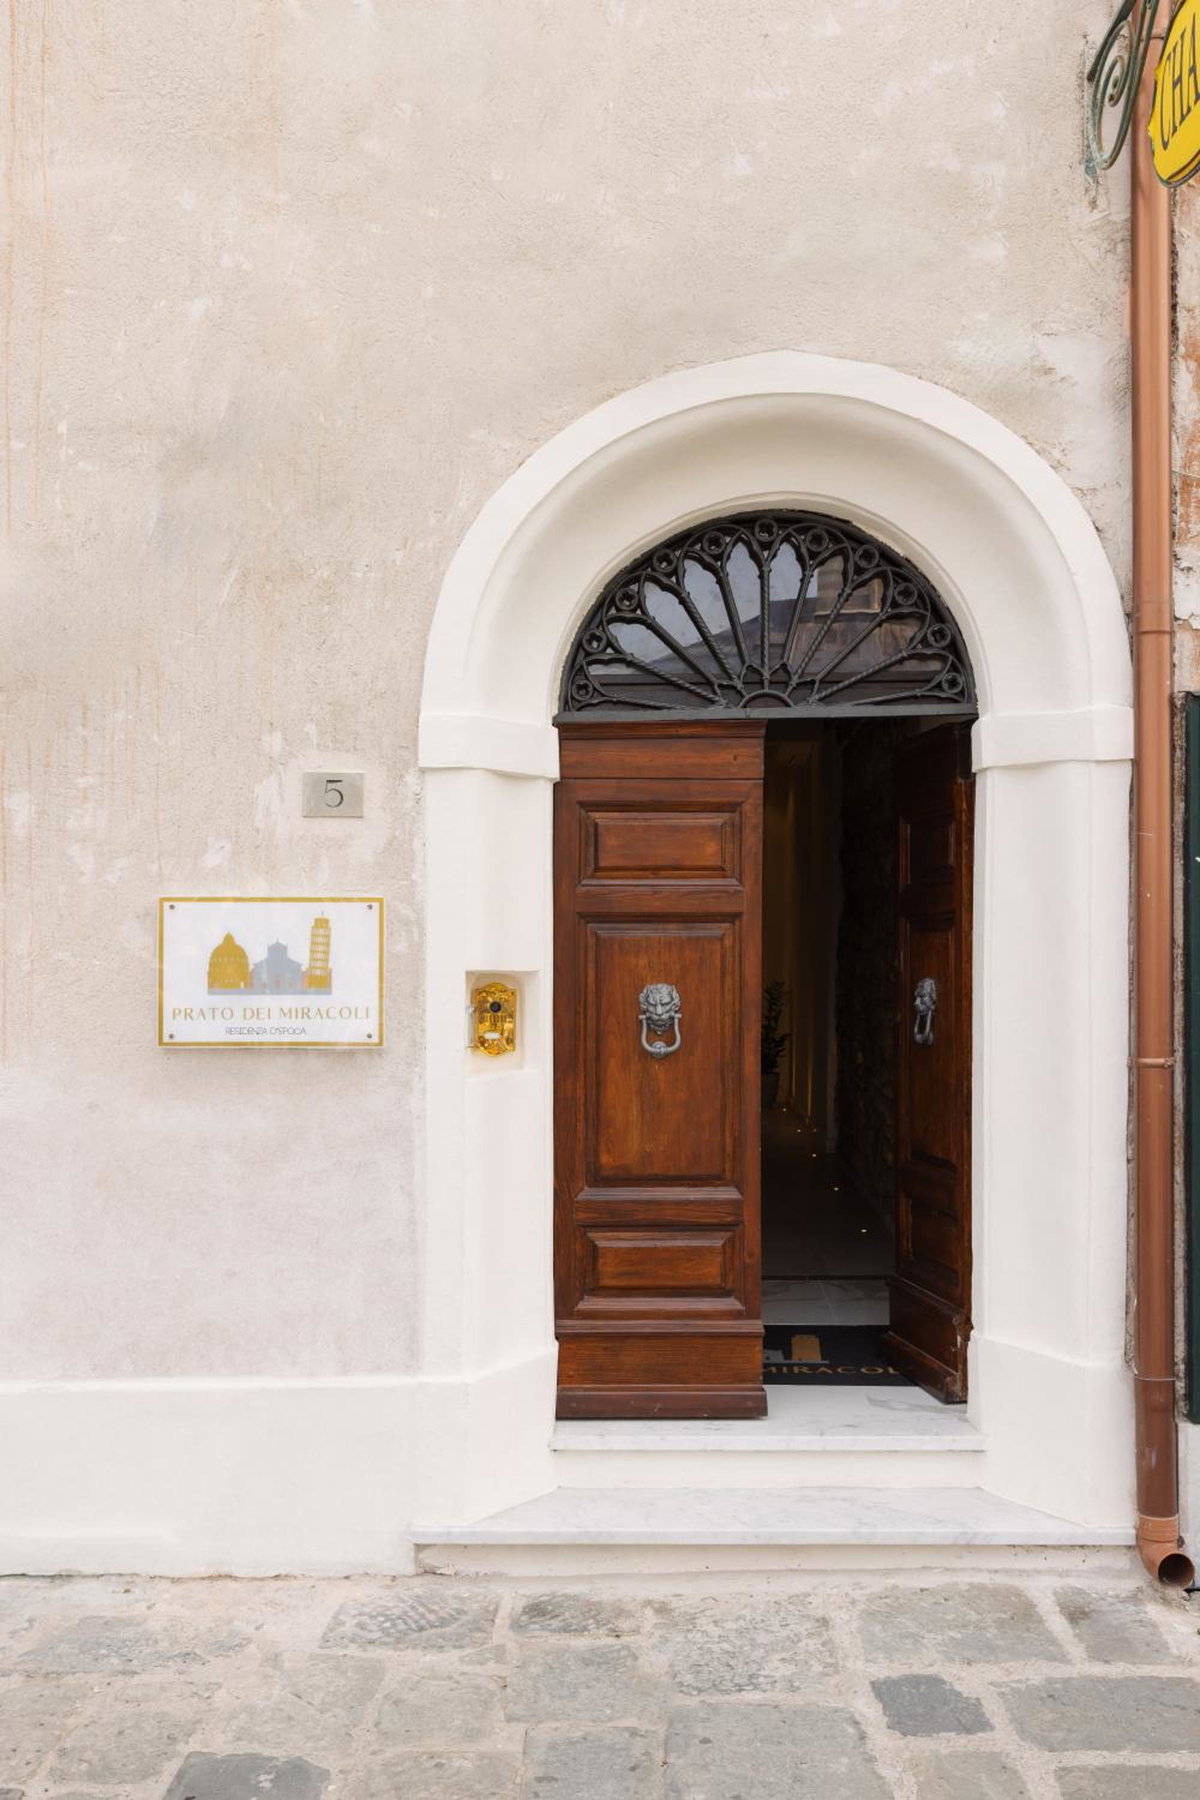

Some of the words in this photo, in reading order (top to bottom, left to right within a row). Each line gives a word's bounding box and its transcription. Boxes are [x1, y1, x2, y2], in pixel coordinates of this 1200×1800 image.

[324, 779, 344, 808] 5
[171, 1007, 234, 1021] PRATO
[242, 1006, 272, 1020] DEI
[279, 1006, 370, 1020] MIRACOLI
[225, 1026, 268, 1036] RESIDENZA
